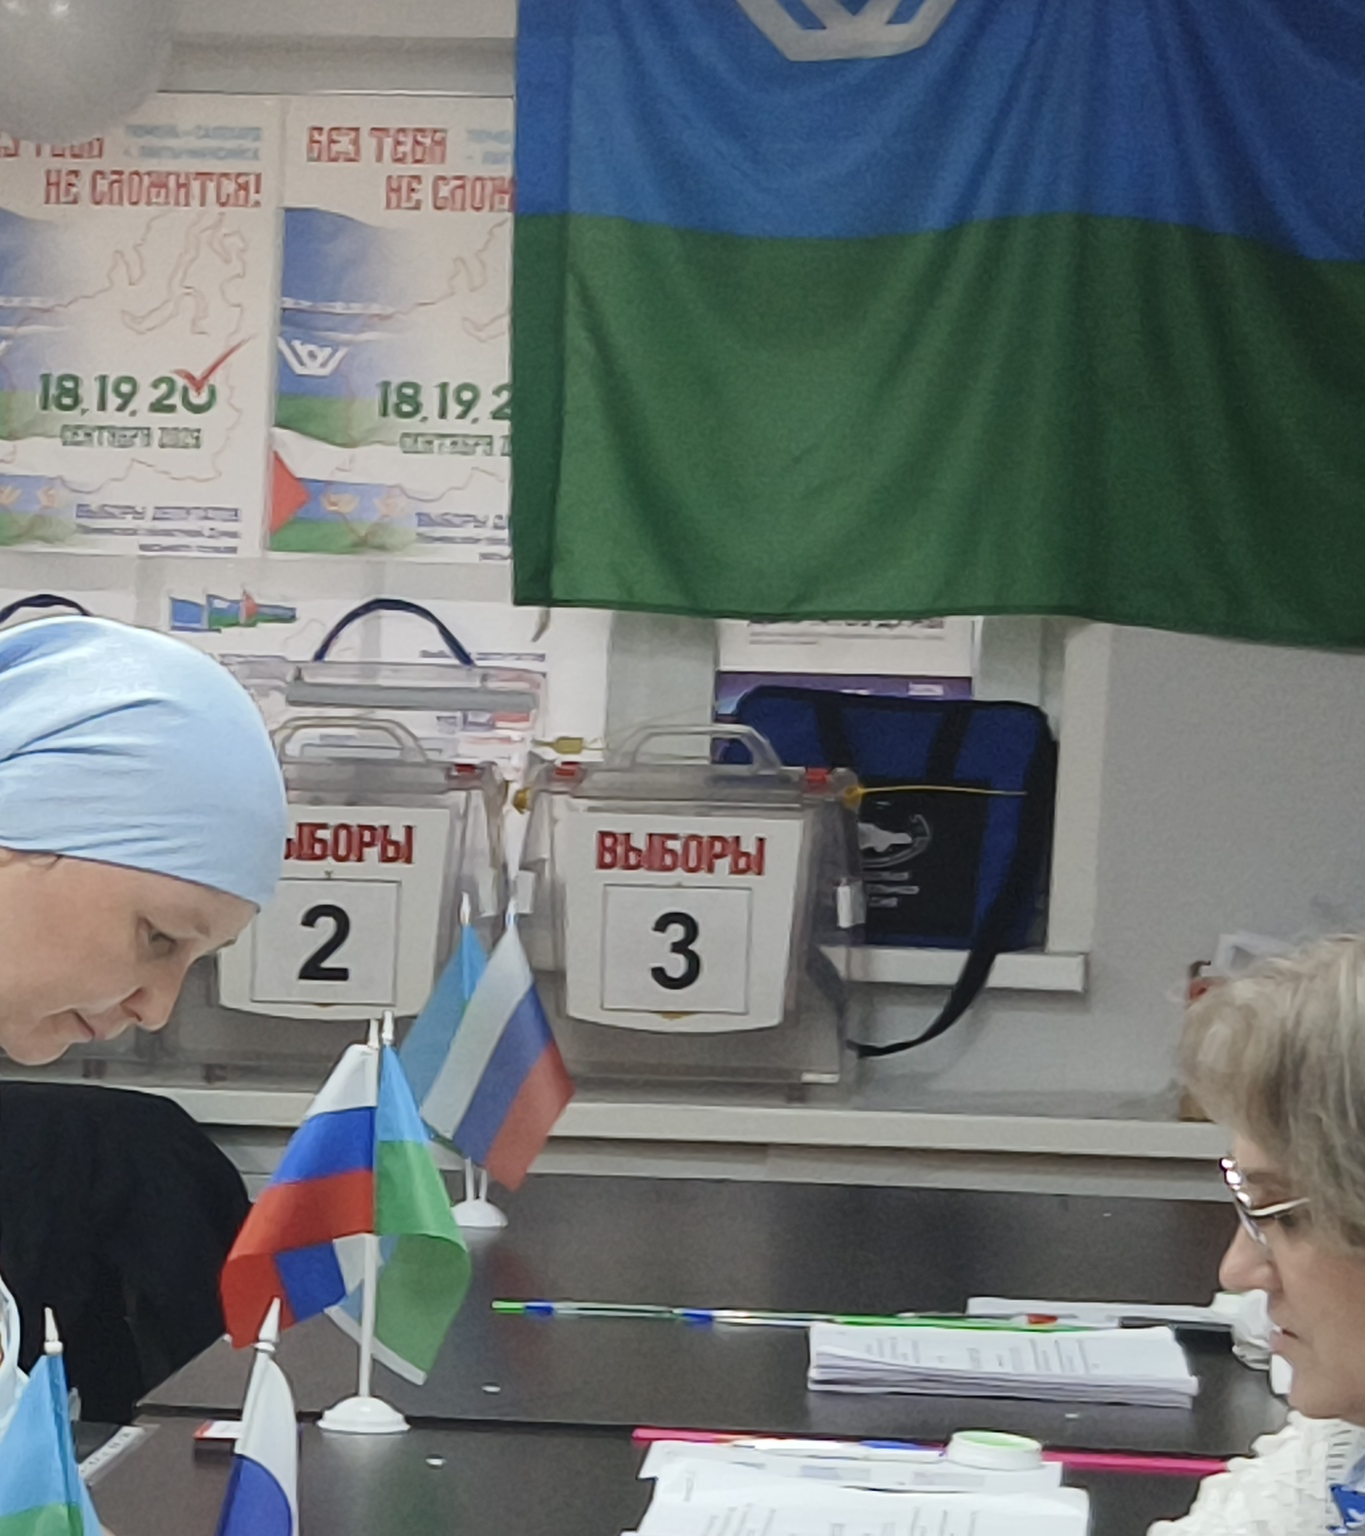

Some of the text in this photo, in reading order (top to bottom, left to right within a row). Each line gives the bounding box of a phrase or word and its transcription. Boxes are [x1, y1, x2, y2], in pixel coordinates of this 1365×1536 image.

[307, 127, 360, 162] БЕЗ
[369, 127, 447, 164] ТЕБЯ
[44, 169, 80, 204] НЕ
[384, 175, 422, 210] НЕ
[284, 823, 415, 864] ЫБОРЫ
[596, 831, 766, 875] ВЫБОРЫ
[298, 904, 350, 981] 2
[651, 912, 700, 990] 3
